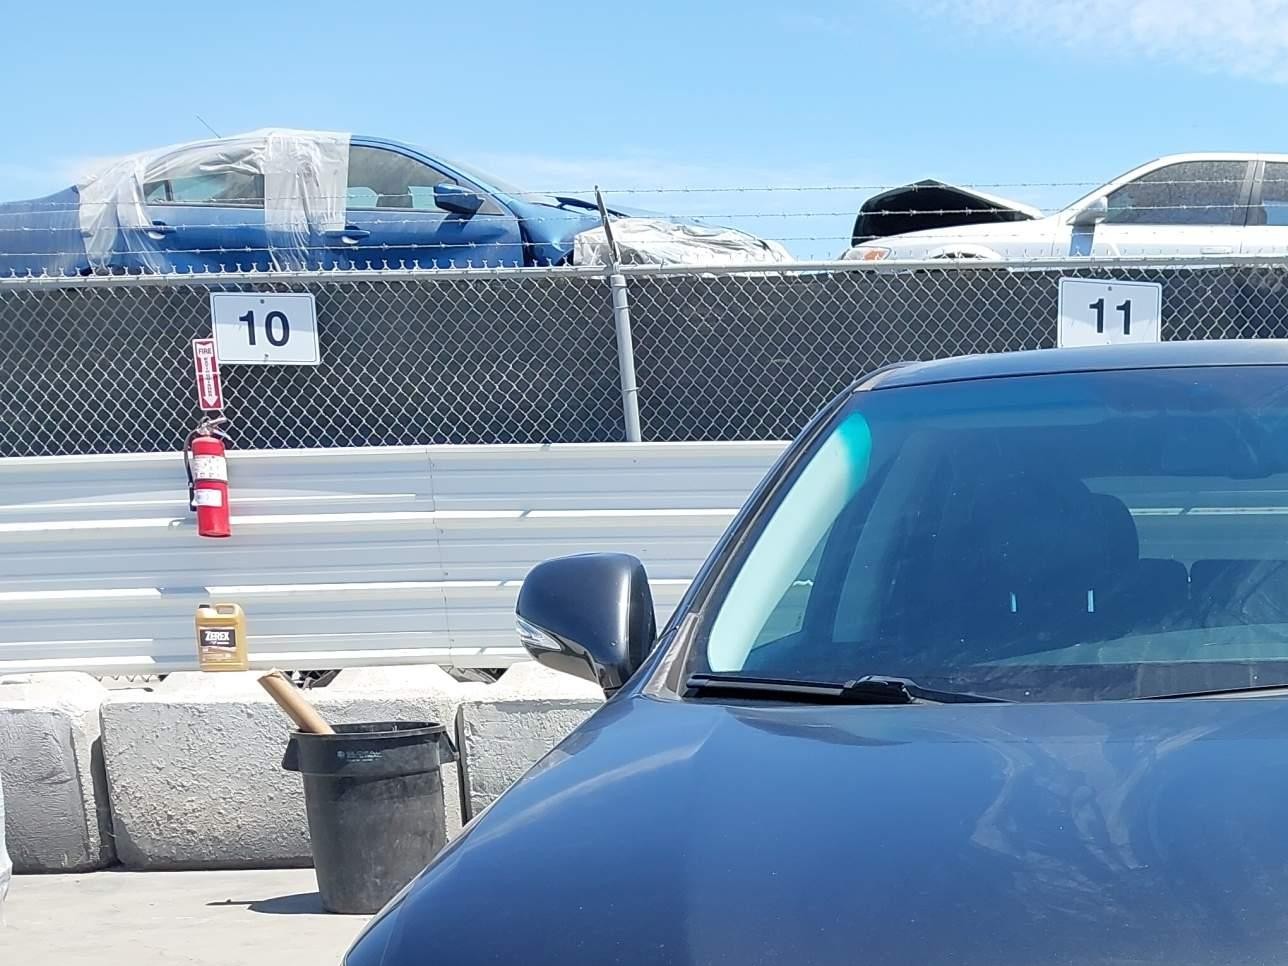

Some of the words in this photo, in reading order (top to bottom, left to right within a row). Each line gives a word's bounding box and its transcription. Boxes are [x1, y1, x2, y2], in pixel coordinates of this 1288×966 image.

[239, 309, 291, 348] 10
[1088, 298, 1132, 336] 11
[205, 631, 230, 640] ZEREX
